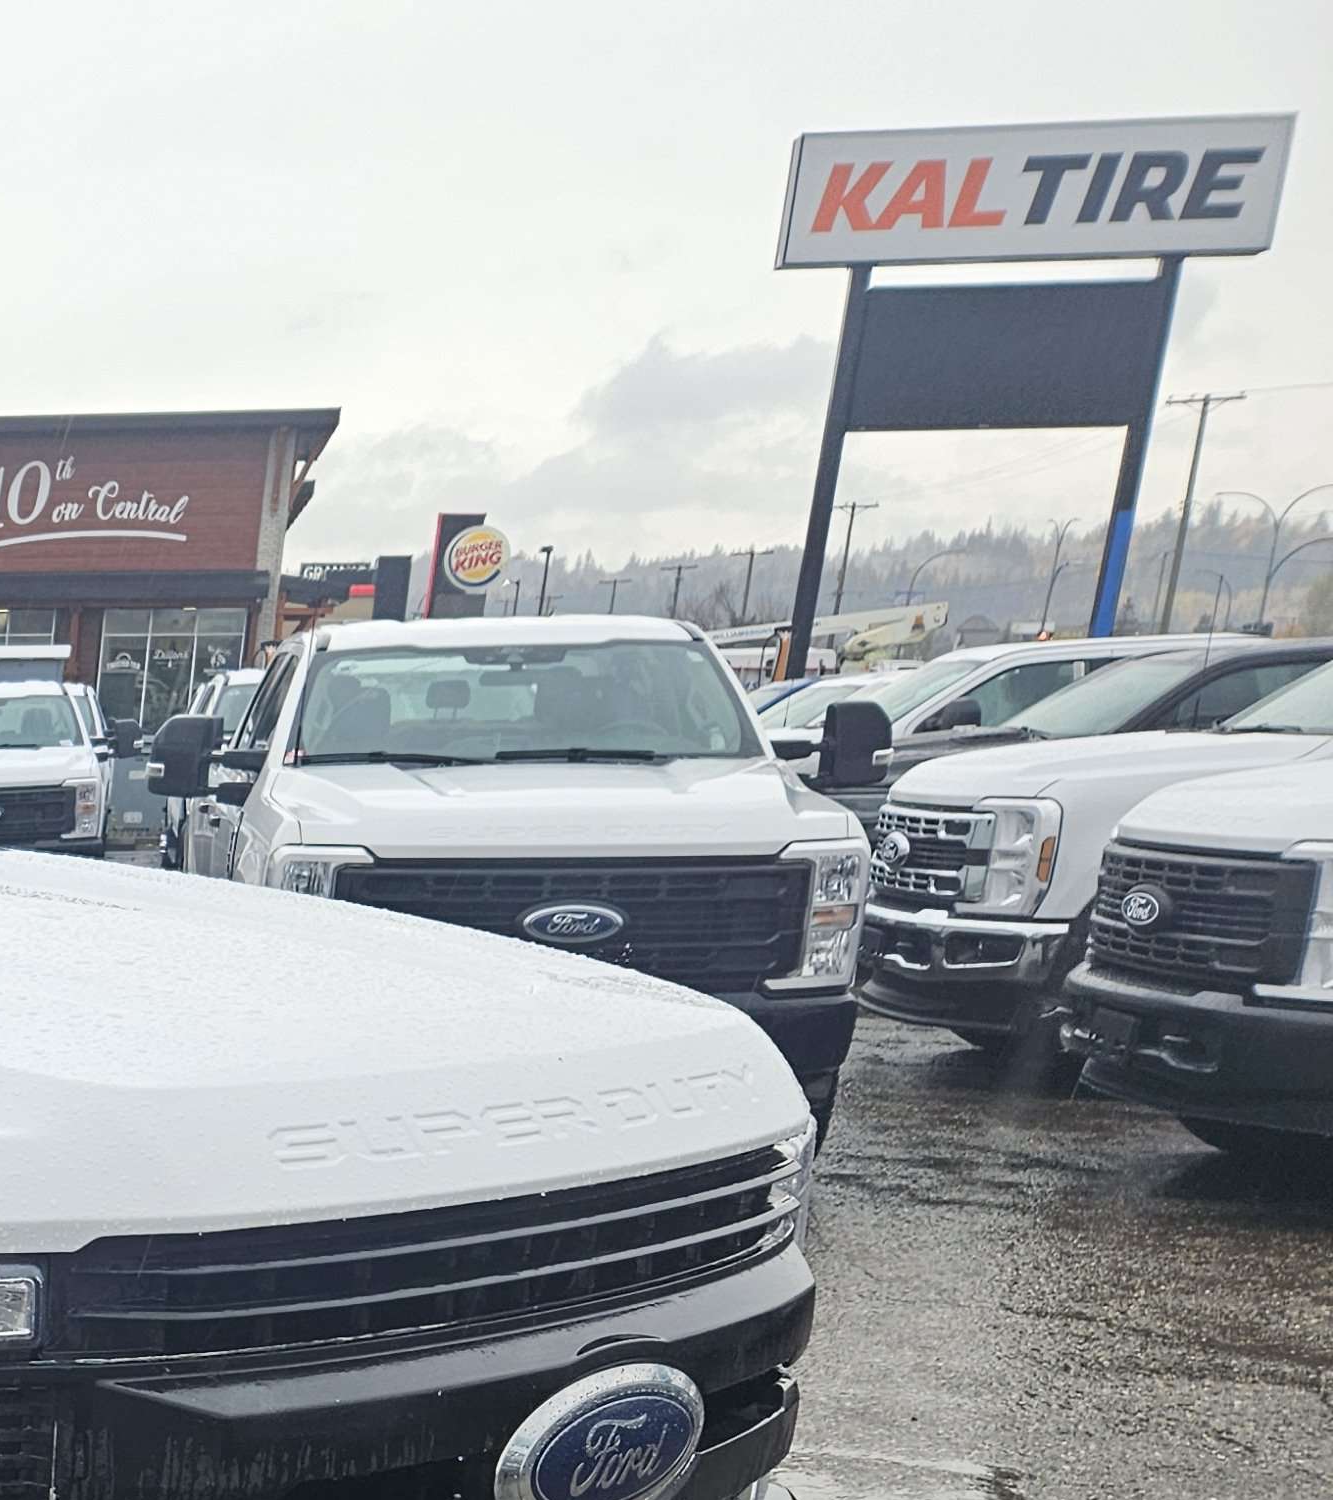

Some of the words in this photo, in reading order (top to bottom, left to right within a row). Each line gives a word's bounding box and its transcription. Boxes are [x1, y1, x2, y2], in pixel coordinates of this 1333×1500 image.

[810, 157, 1006, 232] KAL
[1021, 146, 1267, 225] TIRE
[52, 501, 84, 523] on
[88, 480, 189, 524] Central
[454, 551, 502, 572] KING
[455, 540, 502, 557] BURGER
[547, 913, 600, 934] Ford
[1127, 895, 1151, 919] Ford
[267, 1096, 603, 1171] SUPER
[596, 1064, 755, 1130] DUTY
[569, 1413, 668, 1496] Ford
